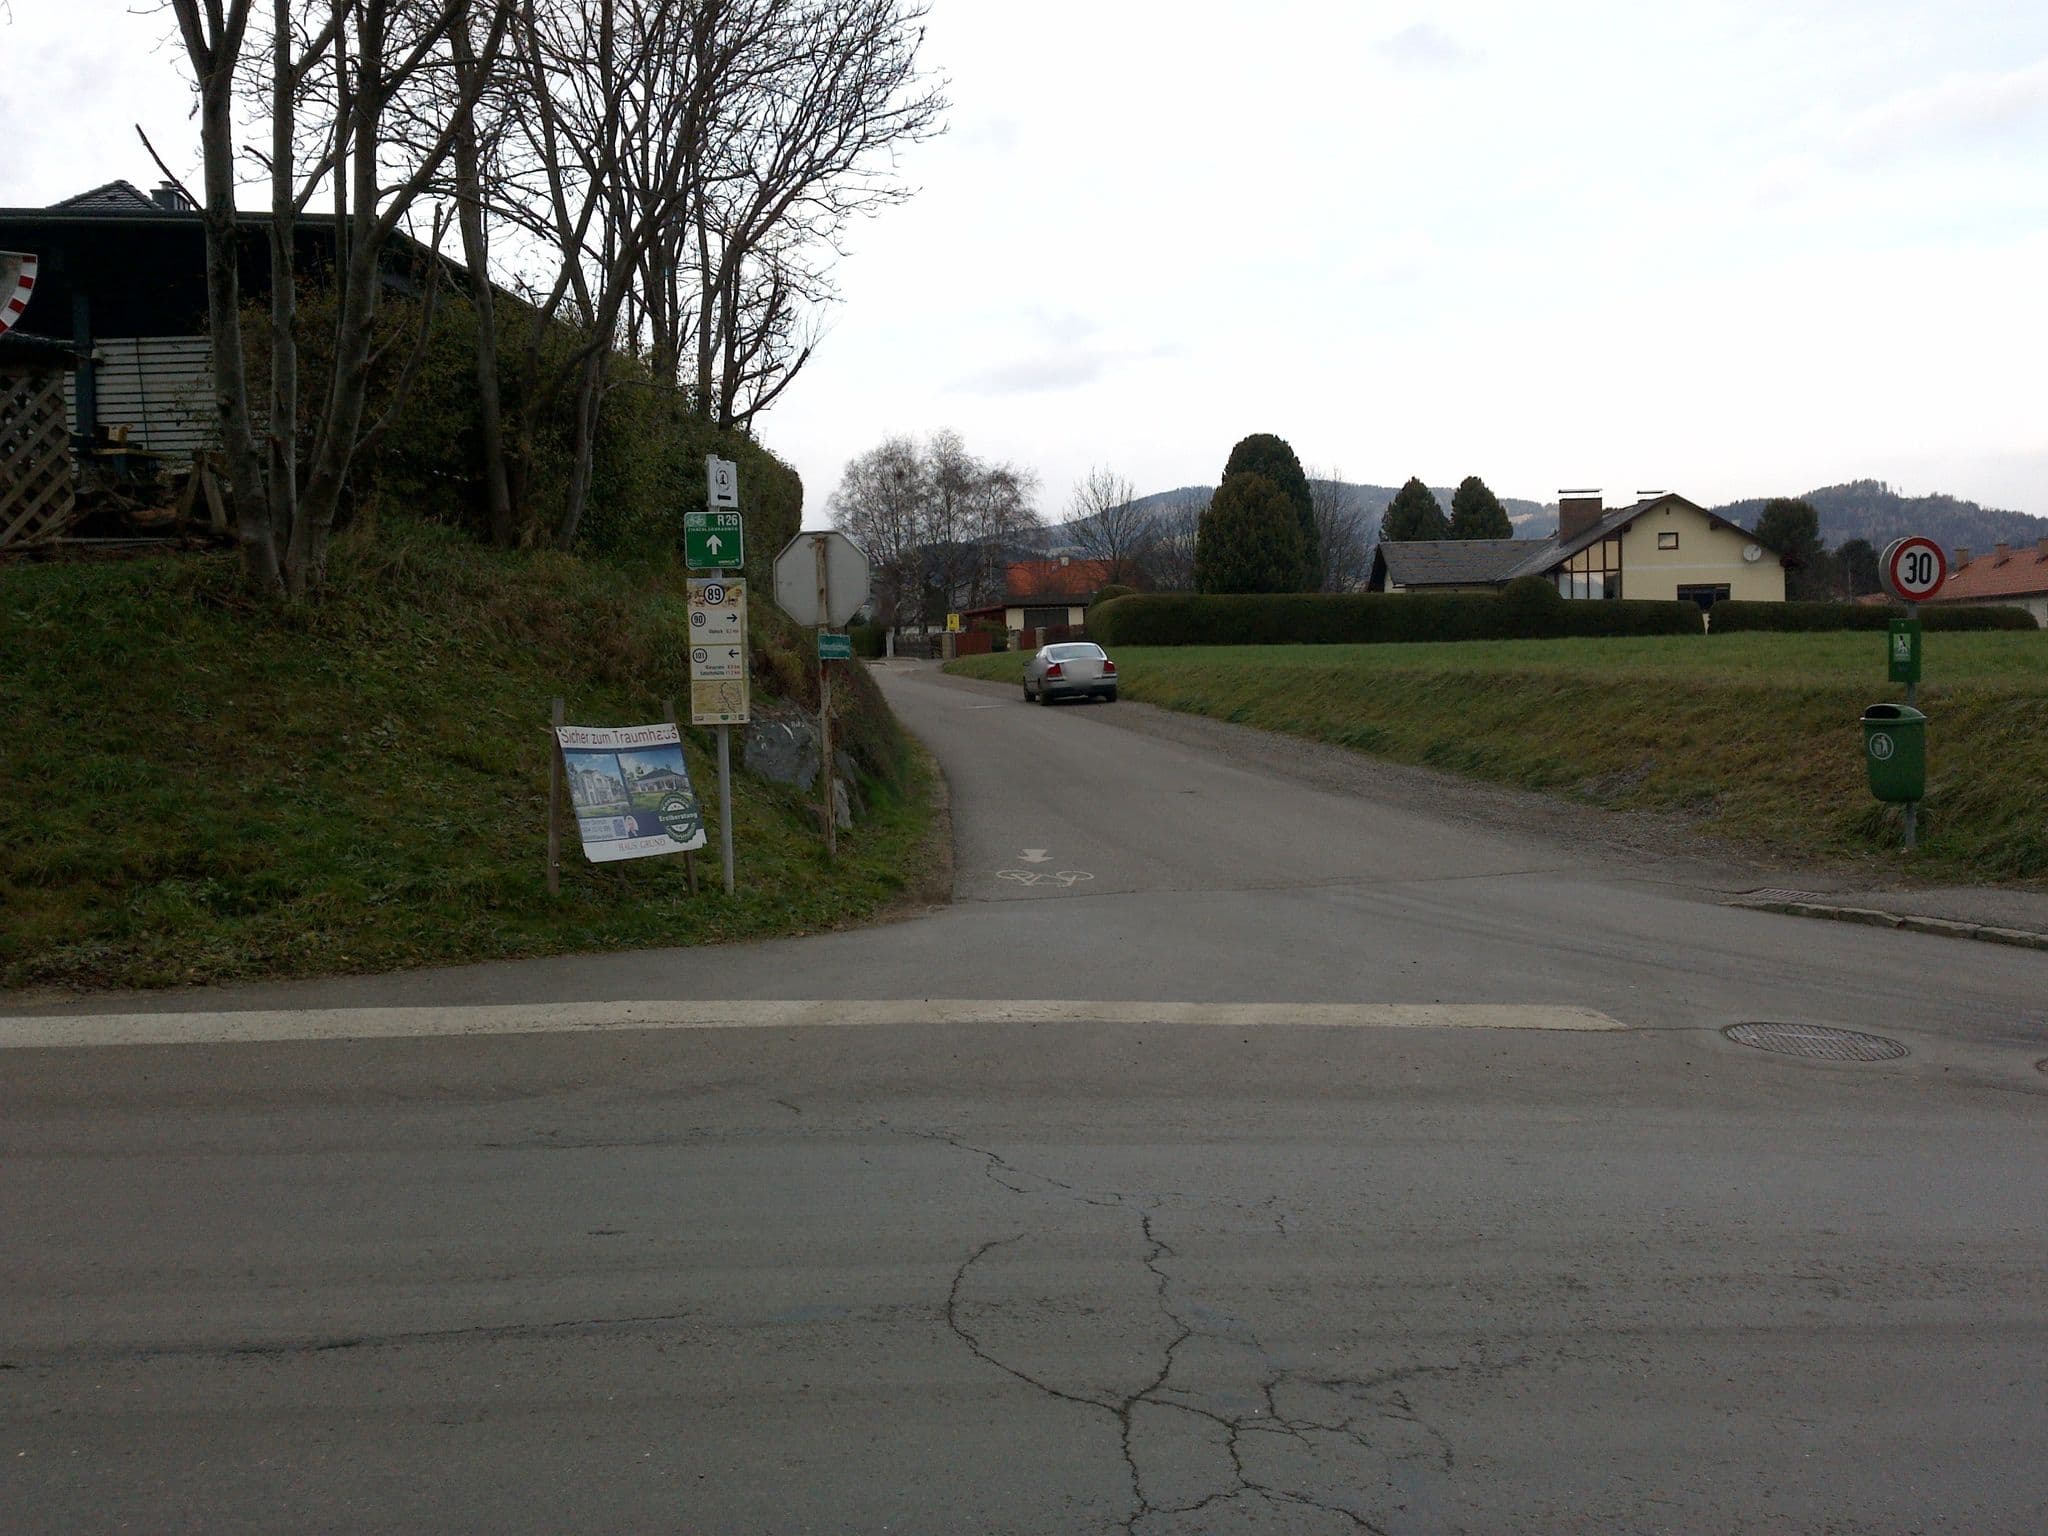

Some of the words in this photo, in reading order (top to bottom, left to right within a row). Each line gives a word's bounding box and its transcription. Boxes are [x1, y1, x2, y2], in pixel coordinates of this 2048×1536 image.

[1904, 552, 1932, 584] 30
[707, 588, 721, 600] 89
[561, 731, 589, 744] Sicher
[592, 733, 611, 745] zum
[612, 728, 678, 744] Traumhaus
